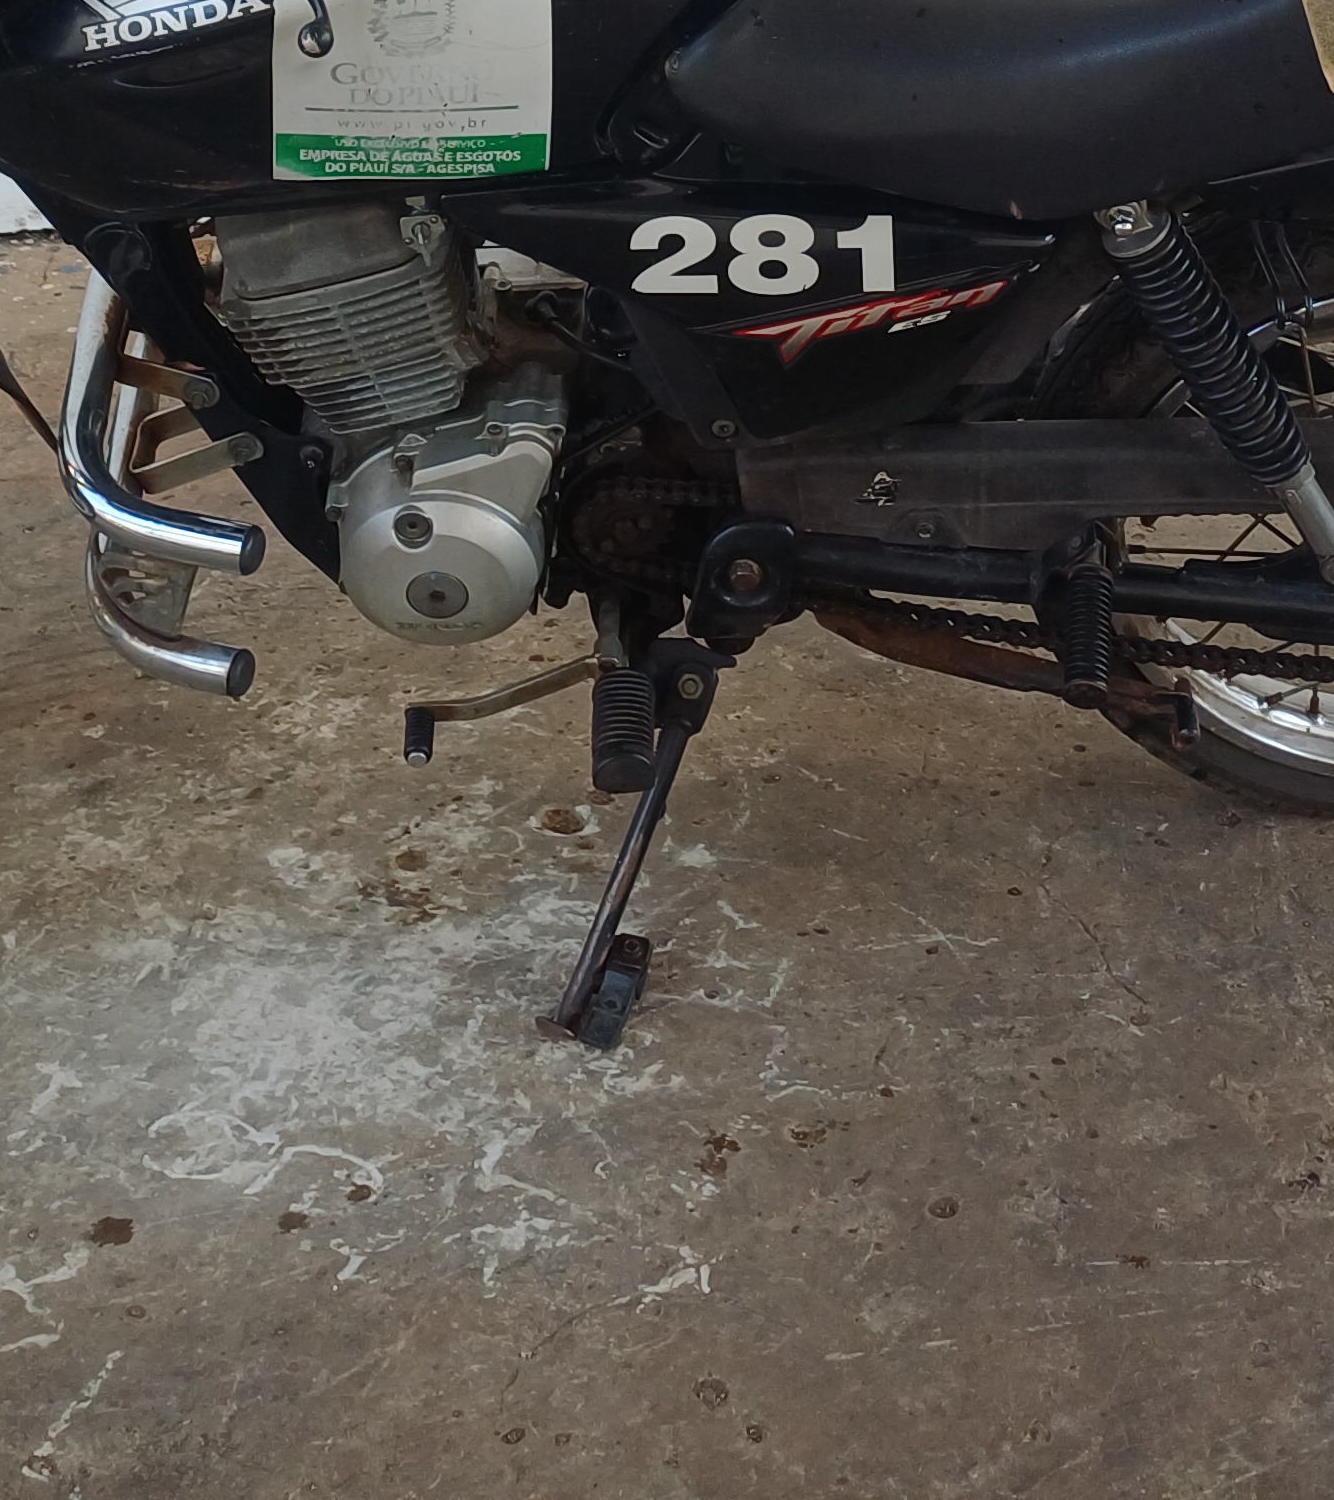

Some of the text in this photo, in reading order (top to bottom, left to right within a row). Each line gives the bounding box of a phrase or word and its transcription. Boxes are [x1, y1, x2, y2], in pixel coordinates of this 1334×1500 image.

[348, 87, 393, 106] DO
[299, 148, 367, 162] EMPRESA
[369, 150, 390, 162] DE
[444, 151, 454, 162] E
[455, 149, 522, 163] ESGOTOS
[324, 162, 347, 173] DO
[426, 162, 497, 175] AGESPISA
[629, 213, 896, 295] 281
